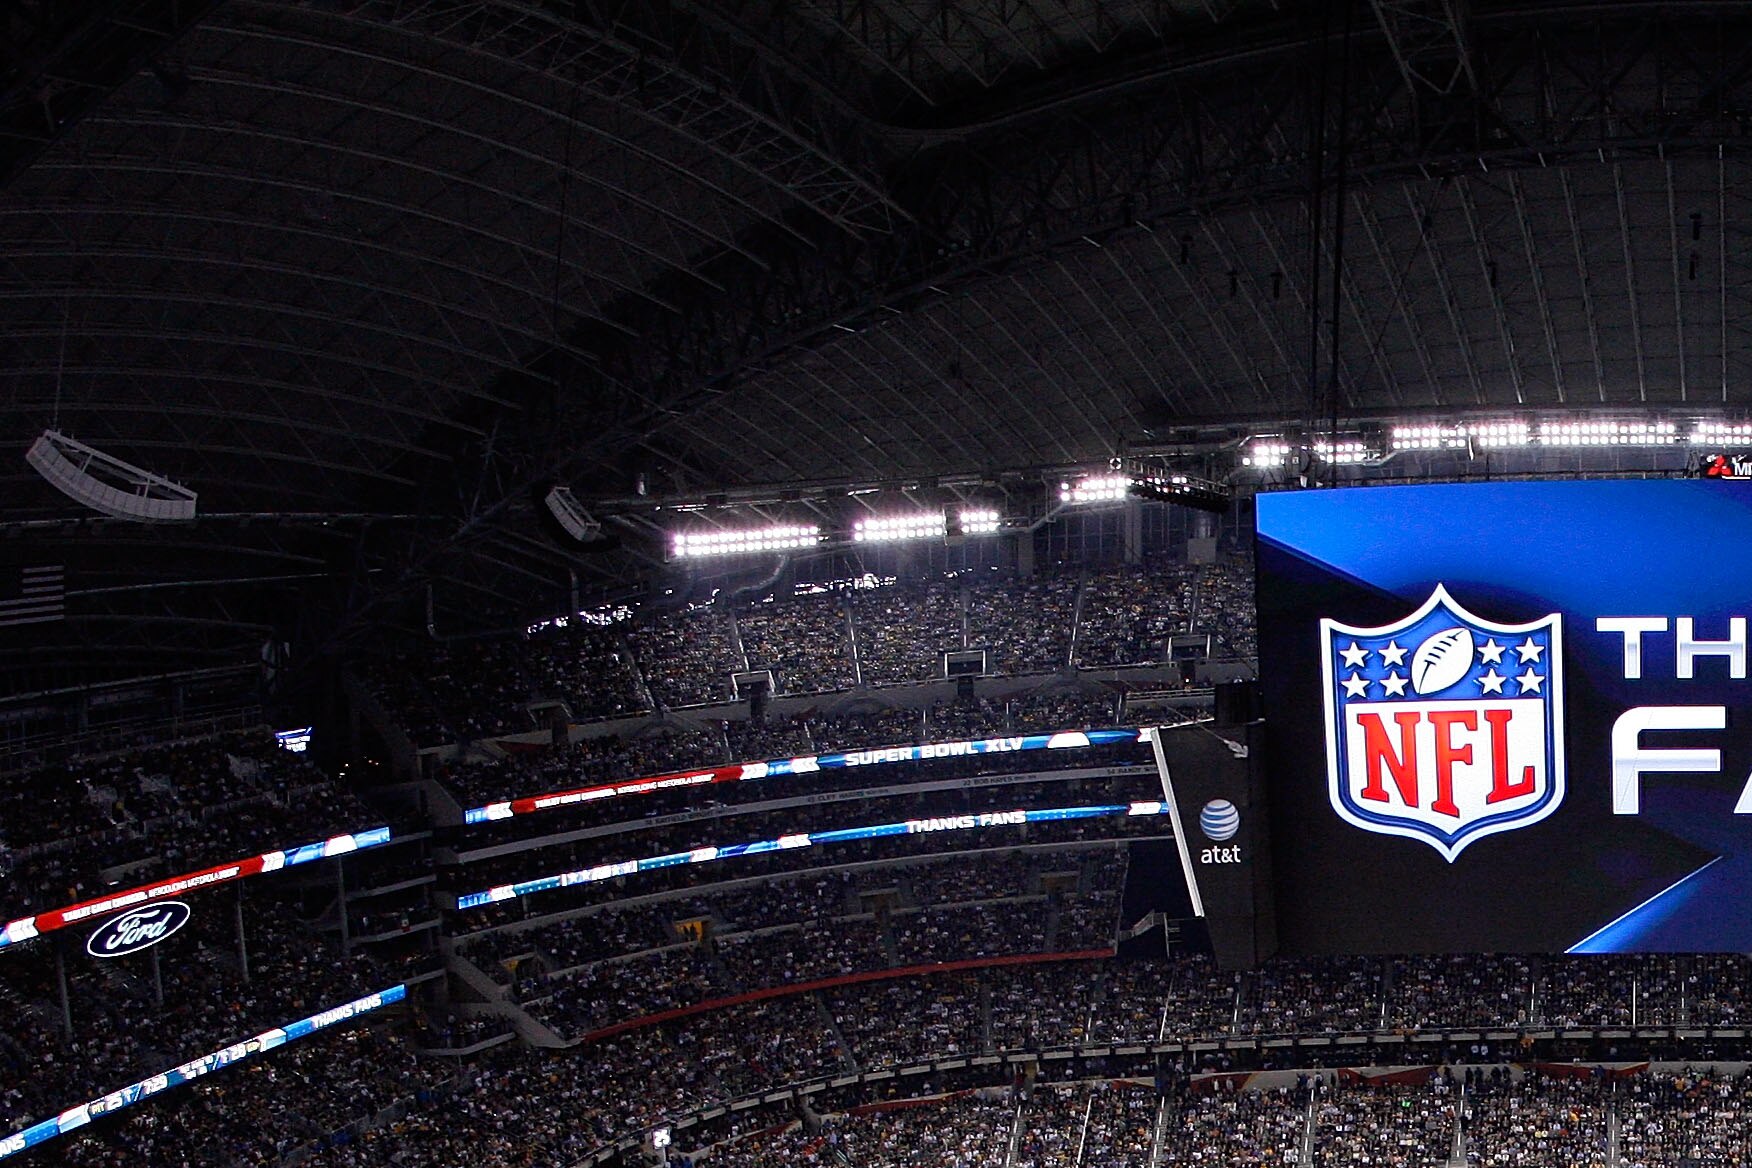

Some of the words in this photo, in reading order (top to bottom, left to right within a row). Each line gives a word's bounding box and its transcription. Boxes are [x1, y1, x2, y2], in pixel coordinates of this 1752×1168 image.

[845, 747, 914, 767] SUPER
[920, 741, 979, 760] BOWL
[985, 736, 1024, 754] XLV
[1355, 707, 1537, 820] NFL
[906, 815, 975, 834] THANKS
[980, 810, 1027, 827] FANS
[1201, 844, 1241, 864] at&t
[107, 909, 173, 949] Ford
[311, 1005, 354, 1030] THANKS
[355, 994, 382, 1014] FANS
